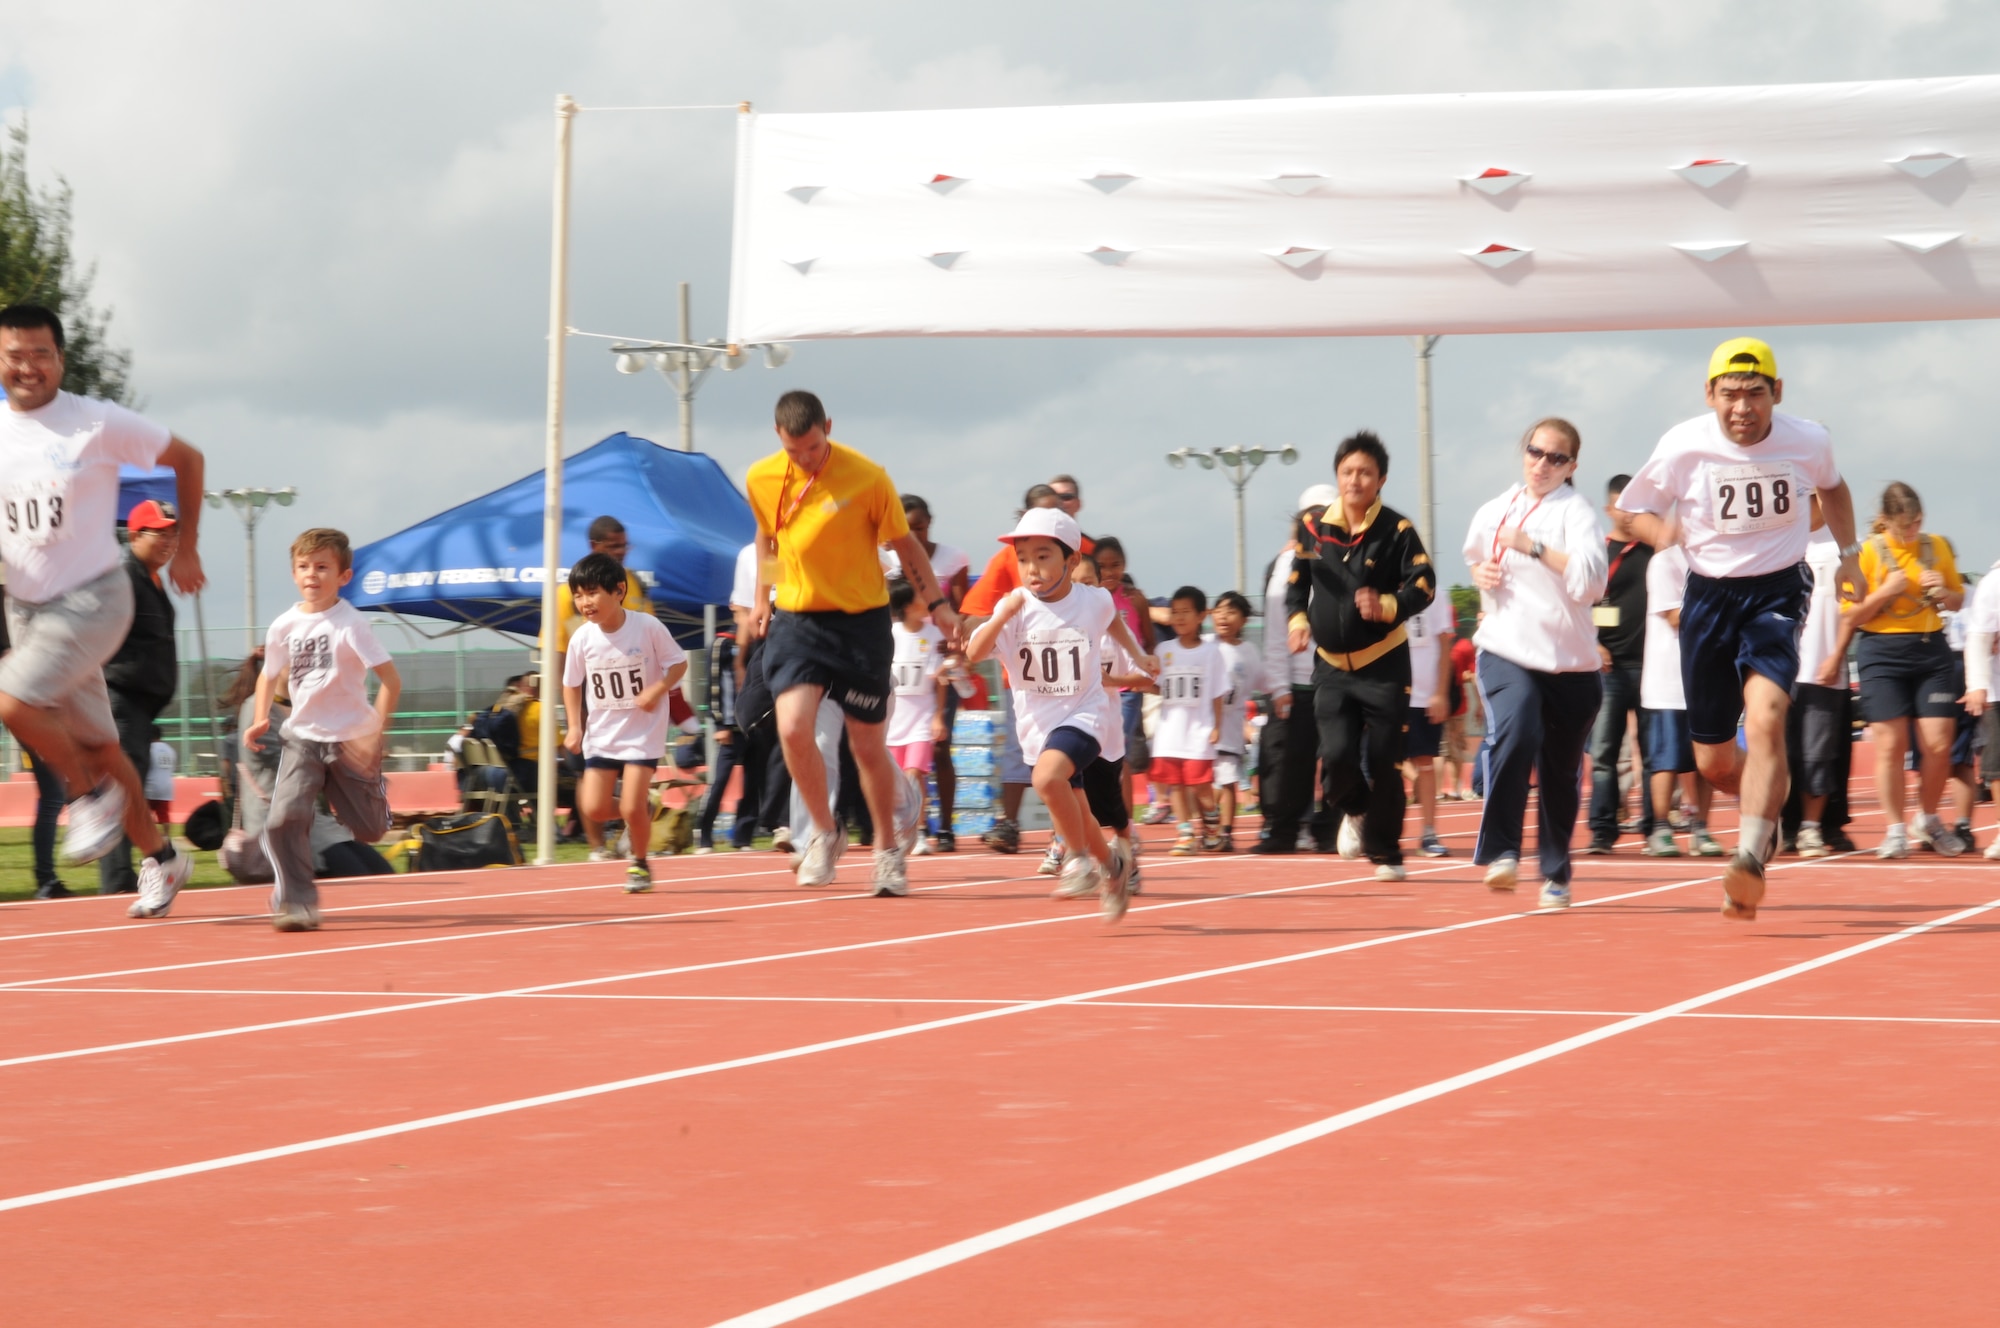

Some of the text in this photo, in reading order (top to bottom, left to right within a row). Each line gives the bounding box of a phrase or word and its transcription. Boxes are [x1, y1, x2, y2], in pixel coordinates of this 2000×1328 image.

[7, 496, 63, 532] 903
[1718, 479, 1790, 520] 298
[1019, 646, 1081, 683] 201
[592, 669, 643, 700] 805
[844, 688, 881, 711] NAVY
